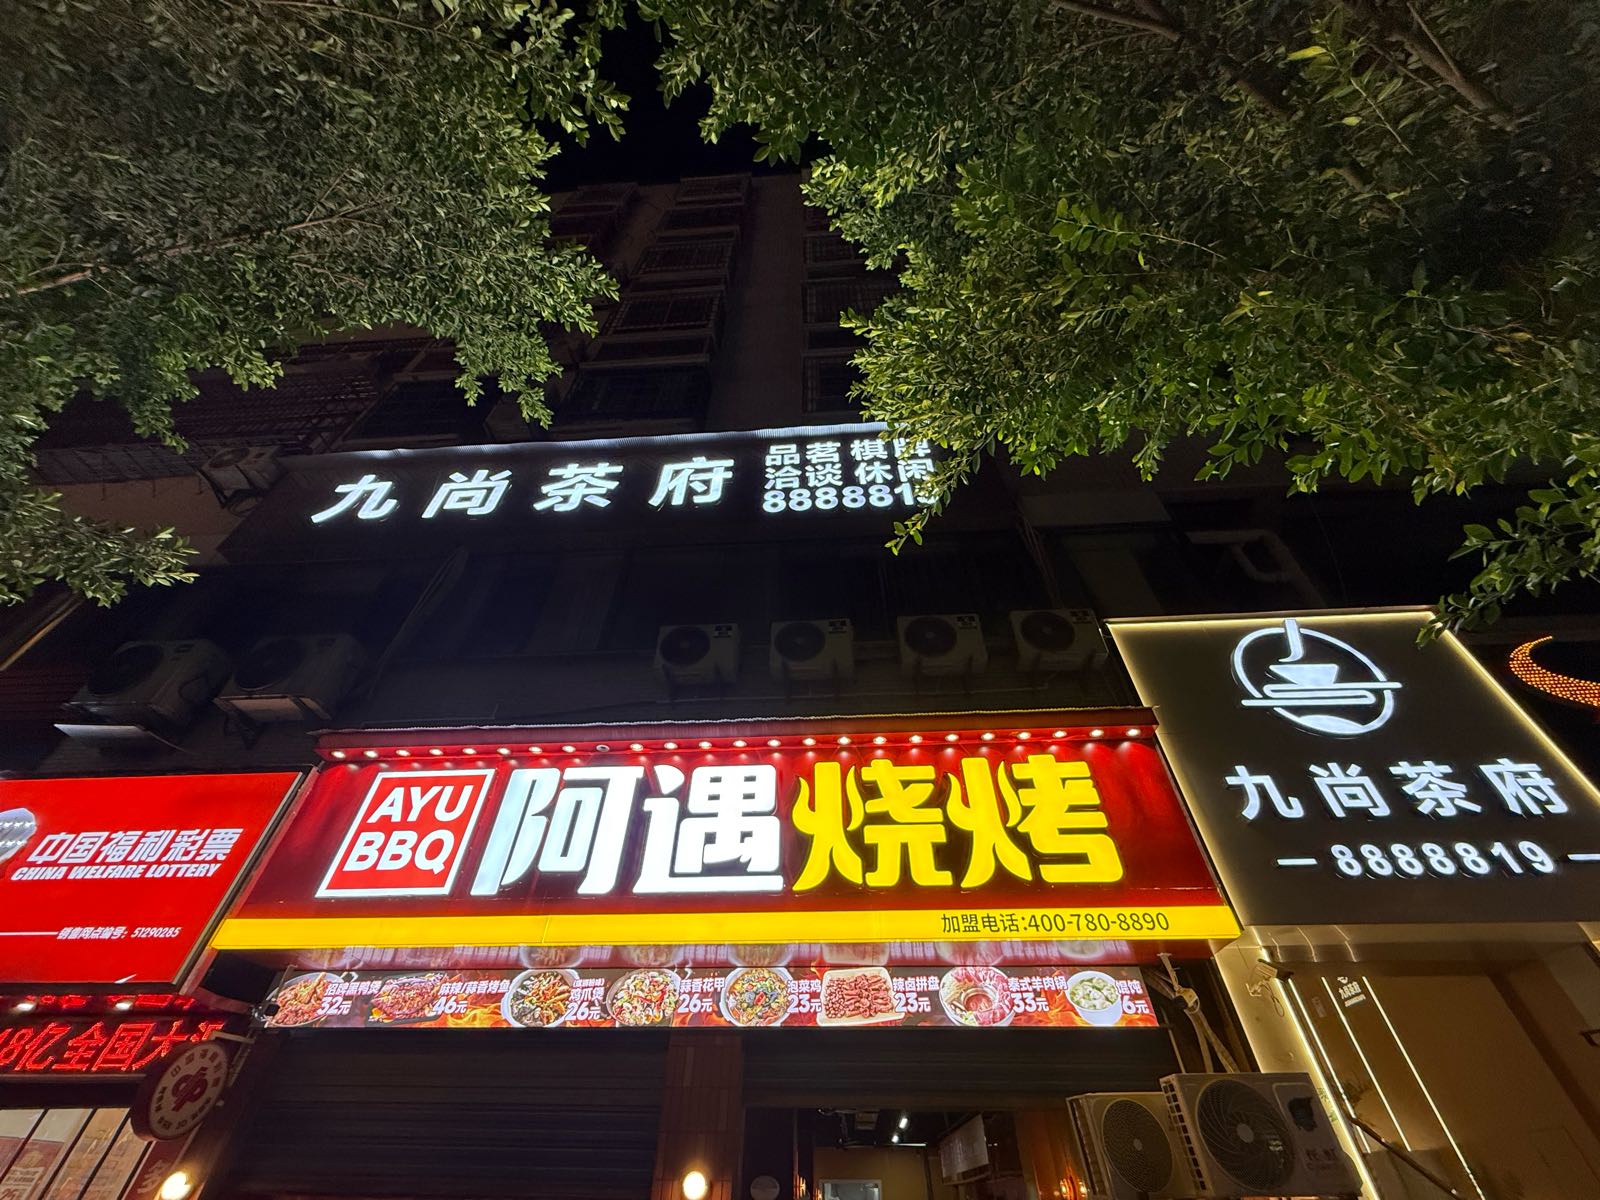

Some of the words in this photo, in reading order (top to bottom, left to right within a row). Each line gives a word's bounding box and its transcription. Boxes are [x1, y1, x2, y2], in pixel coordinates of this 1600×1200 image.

[764, 458, 934, 490] 洽谈休闲
[310, 456, 735, 523] 九尚茶府
[762, 484, 940, 513] 888881
[1225, 758, 1570, 820] 九尚茶府
[366, 785, 475, 824] AYU
[469, 755, 1125, 897] 阿遇烧烤
[26, 828, 244, 864] 中国福利彩票
[342, 829, 455, 875] BBQ
[1330, 840, 1556, 877] 8888819
[10, 866, 65, 881] CHINA
[67, 864, 147, 879] WELFARE
[148, 863, 222, 878] LOTTERY
[941, 912, 1169, 933] 加盟电话:400-780-8890
[680, 977, 725, 993] 蒜香花甲
[787, 980, 821, 993] 泡菜鸡
[316, 996, 352, 1015] 32元
[432, 996, 468, 1015] 46元
[564, 1001, 601, 1020] 26元
[678, 993, 713, 1013] 26元
[787, 994, 822, 1013] 23元
[894, 992, 932, 1013] 23元
[1010, 992, 1050, 1013] 33元
[1122, 995, 1150, 1014] 6元
